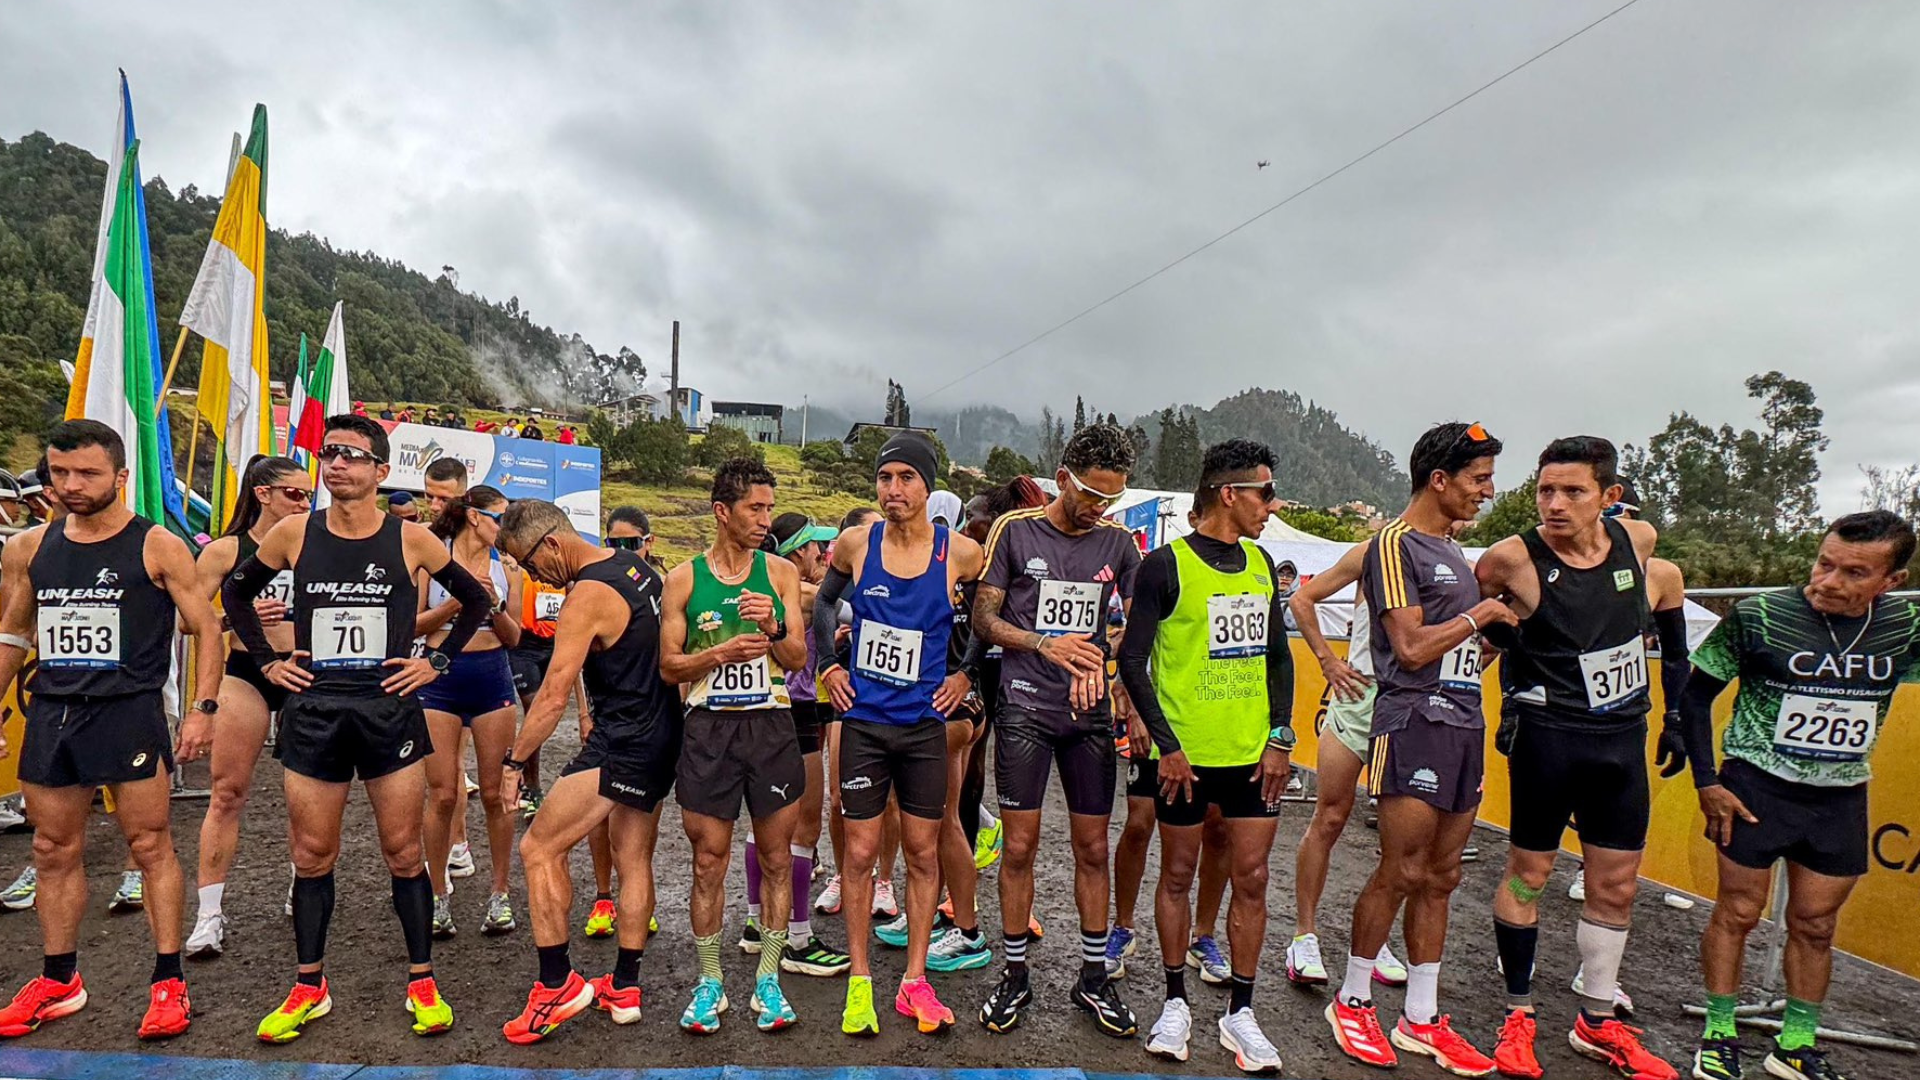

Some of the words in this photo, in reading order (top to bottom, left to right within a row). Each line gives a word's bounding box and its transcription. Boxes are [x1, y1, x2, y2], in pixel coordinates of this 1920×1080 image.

[37, 588, 124, 606] UNLEASH
[306, 582, 393, 601] UNLEASH
[1043, 598, 1096, 628] 3875
[46, 625, 113, 655] 1553
[332, 626, 366, 655] 70
[1214, 612, 1265, 644] 3863
[866, 639, 915, 675] 1551
[1788, 651, 1893, 681] CAFU
[711, 662, 765, 691] 2661
[1198, 671, 1228, 686] The
[1592, 655, 1642, 699] 3701
[1789, 685, 1845, 696] ATLETISMO
[1195, 686, 1225, 701] The
[1783, 712, 1870, 748] 2263
[611, 781, 646, 797] UNLEASH
